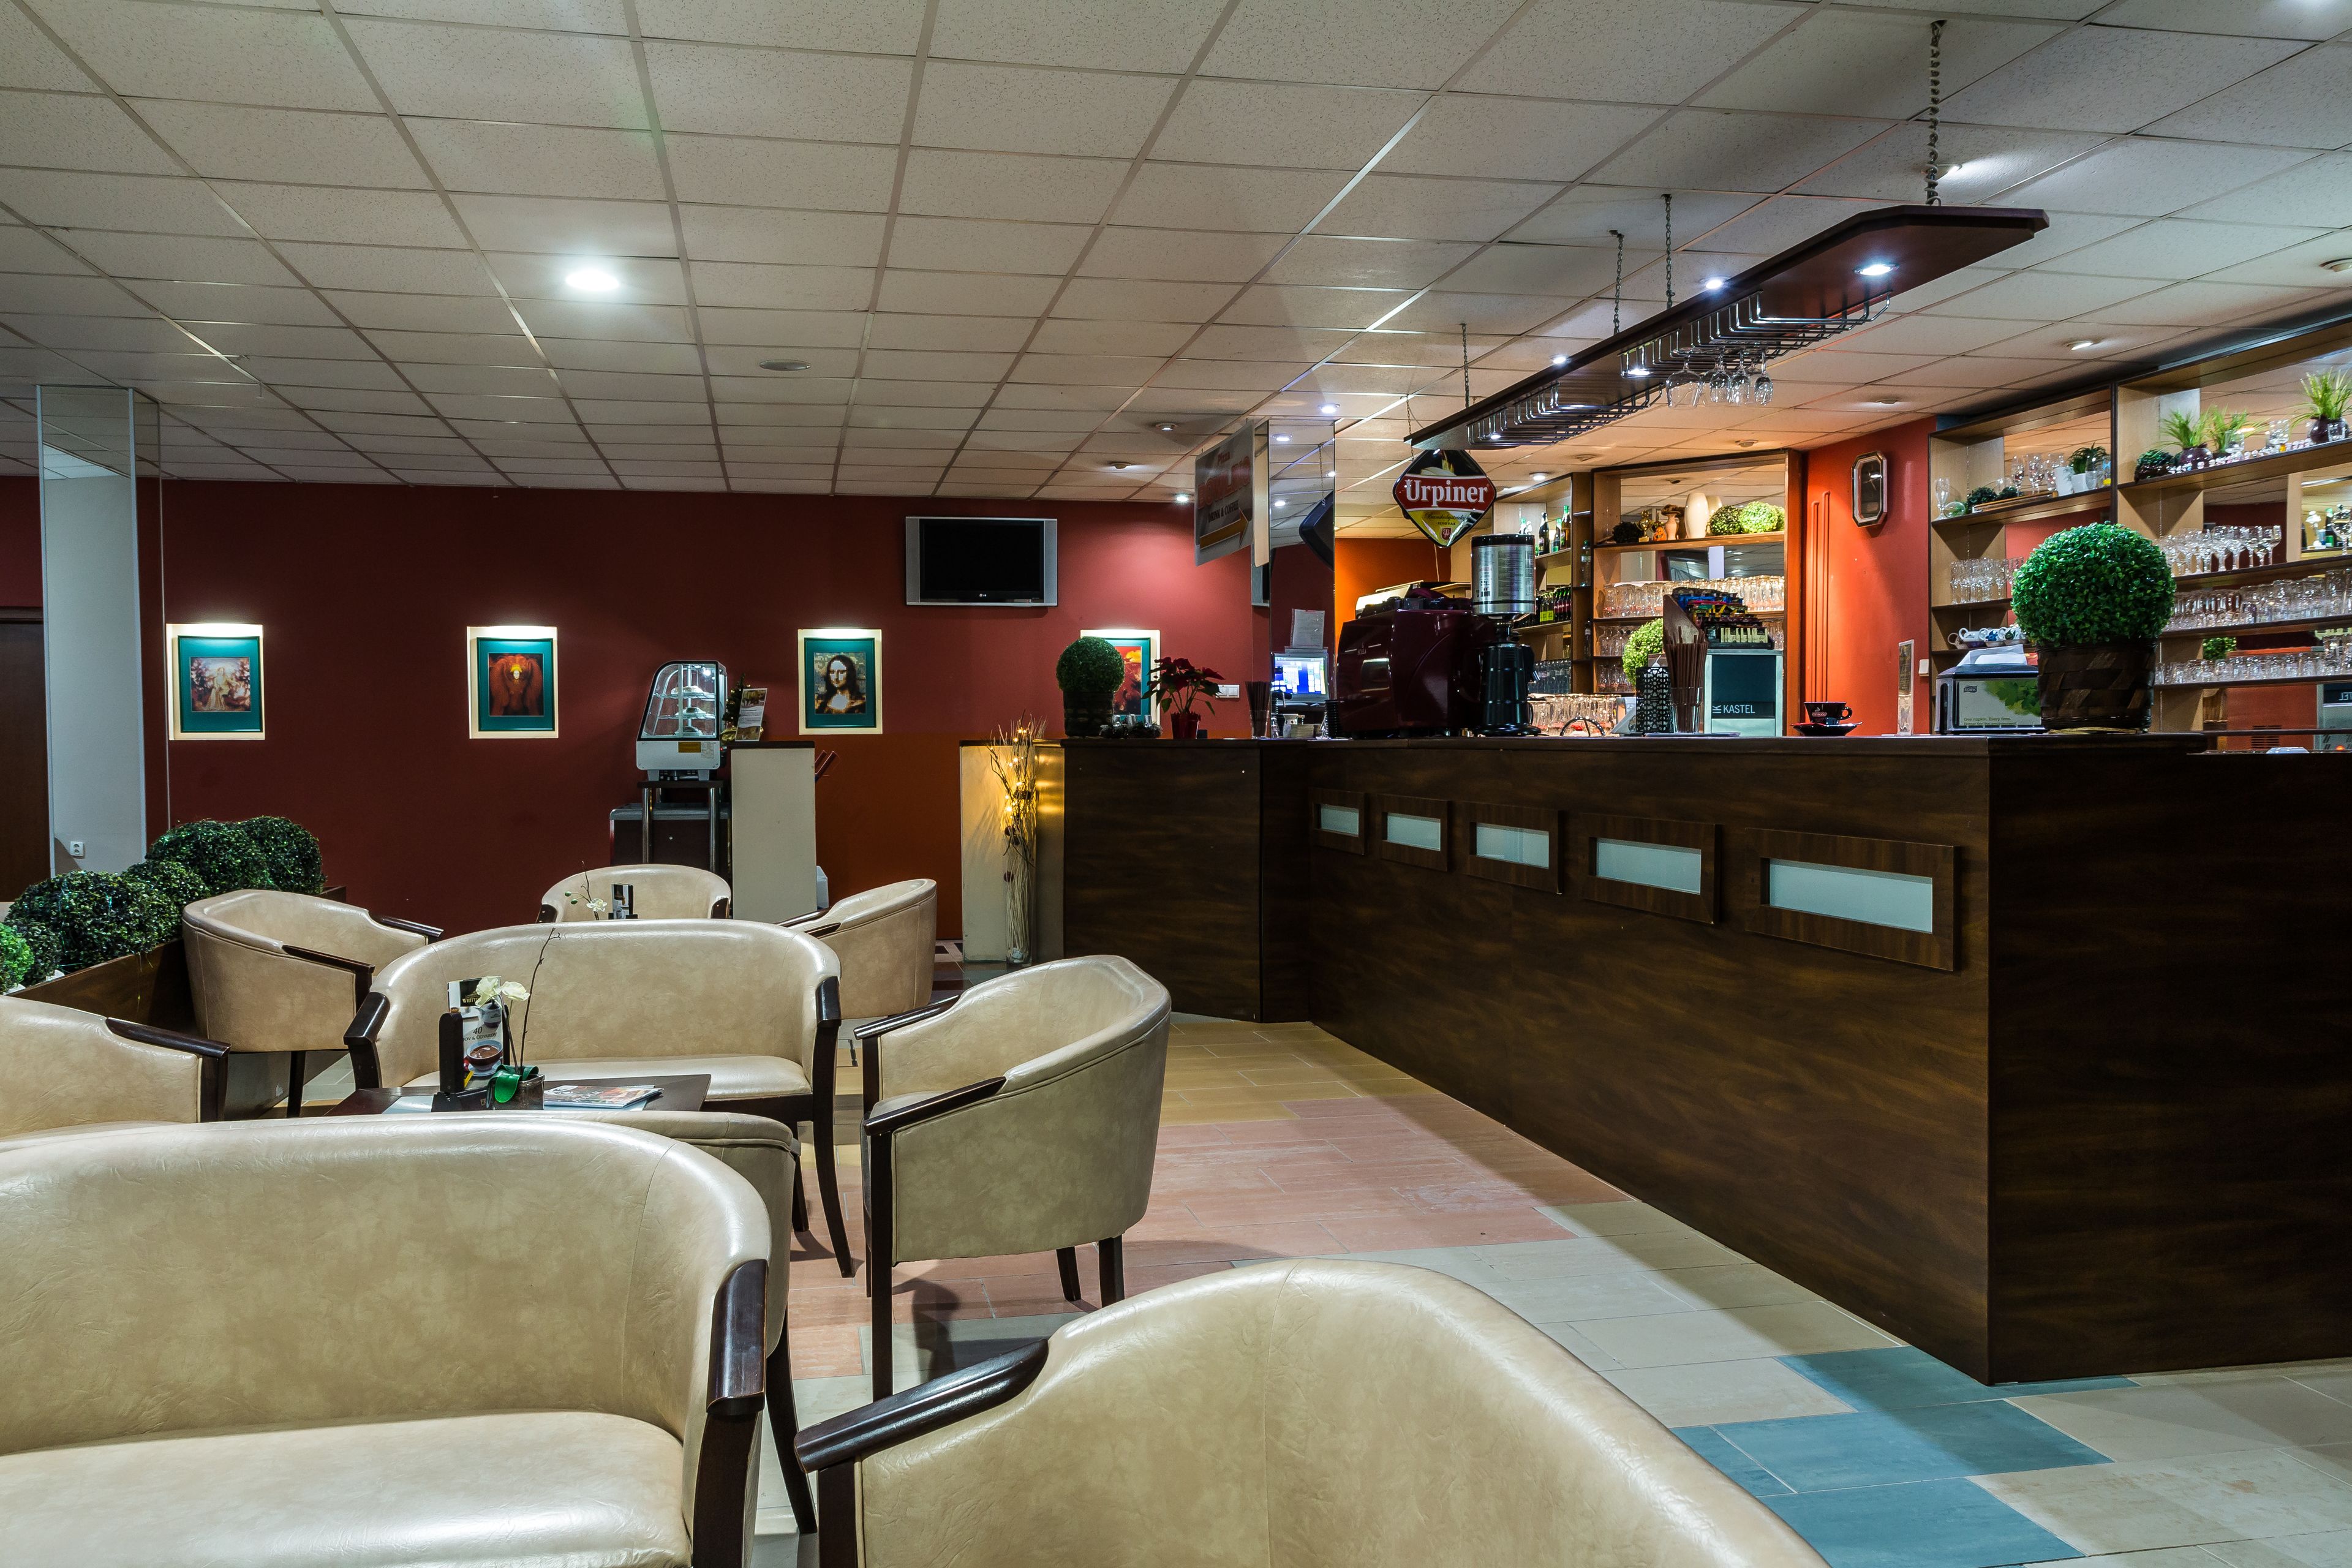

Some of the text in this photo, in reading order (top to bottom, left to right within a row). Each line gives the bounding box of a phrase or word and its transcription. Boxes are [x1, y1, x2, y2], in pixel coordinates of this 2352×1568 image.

[1197, 456, 1250, 510] BOWLING
[1404, 480, 1488, 507] Urpiner
[1208, 500, 1239, 523] DRINK & COFFEE
[1723, 704, 1755, 714] KASTEL
